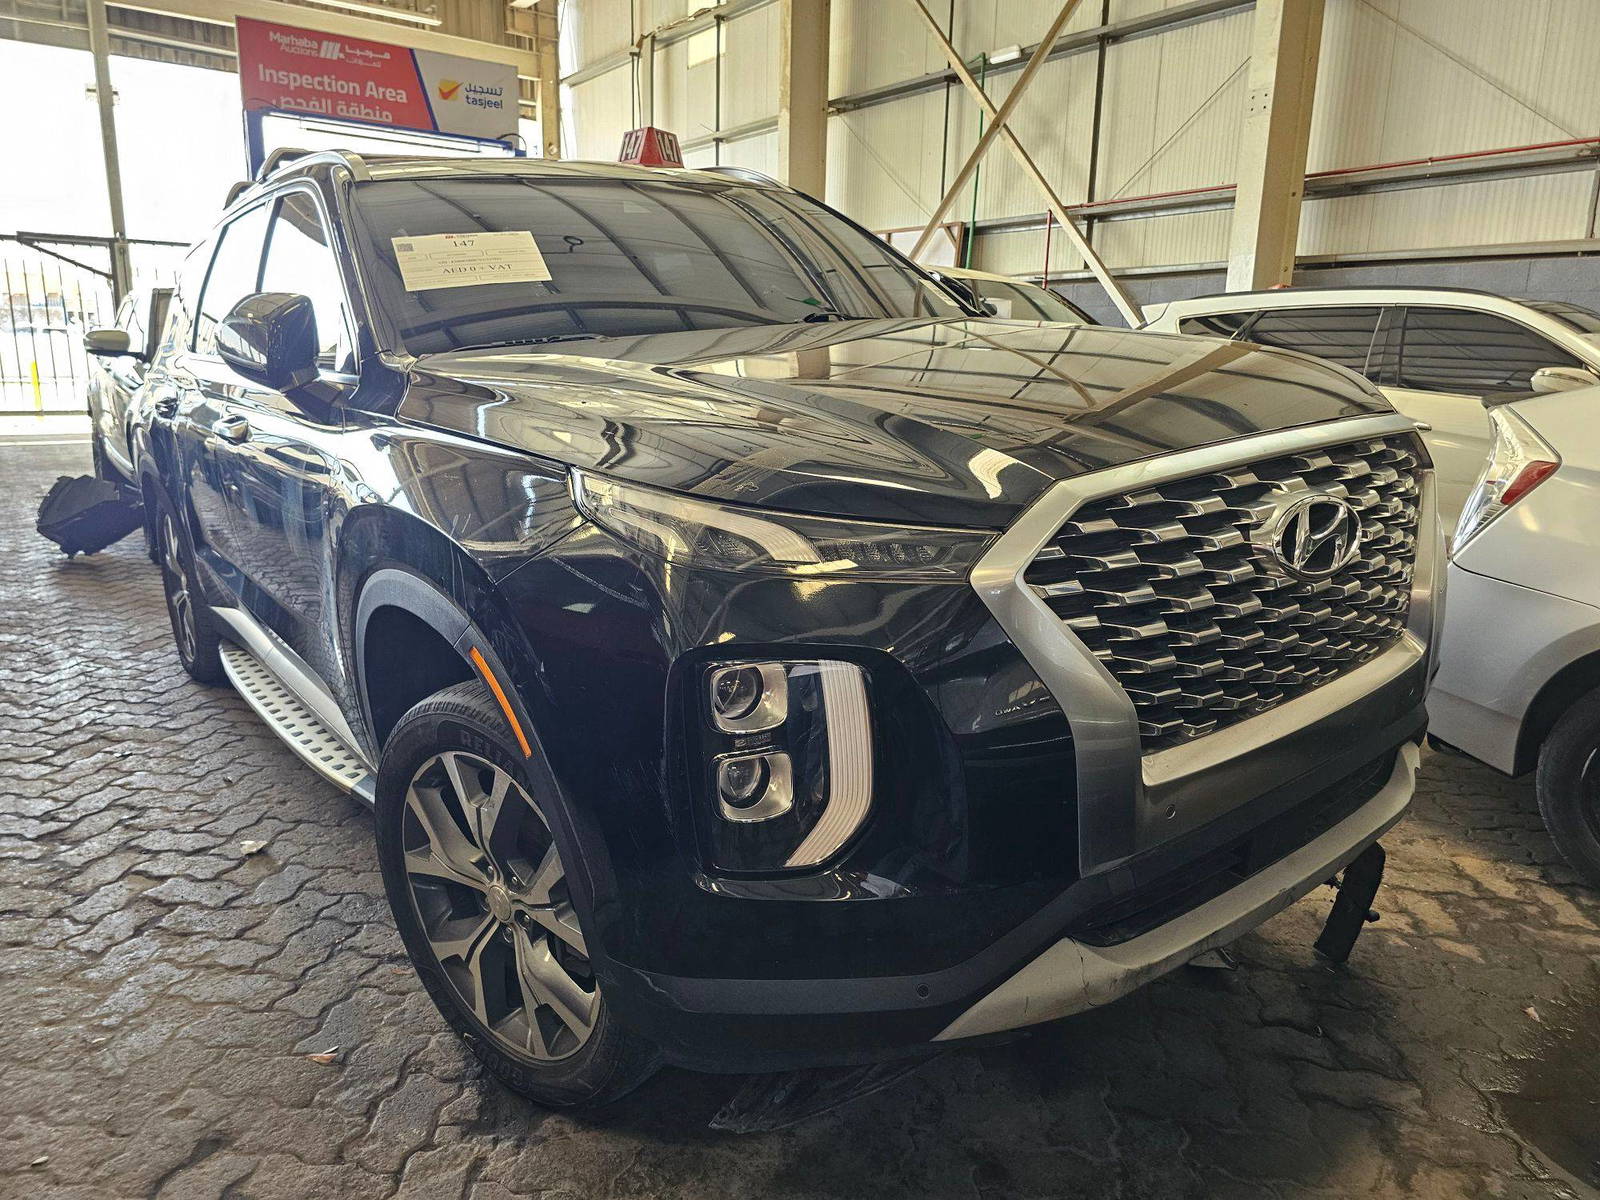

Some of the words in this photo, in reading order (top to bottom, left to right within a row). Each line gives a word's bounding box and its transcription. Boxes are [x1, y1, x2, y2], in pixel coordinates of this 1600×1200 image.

[269, 31, 318, 49] Marhaba
[280, 44, 318, 57] Auctions
[345, 44, 391, 59] مرحبا
[258, 63, 361, 96] Inspection
[365, 81, 408, 103] Area
[465, 83, 503, 97] تسجيل
[466, 95, 503, 109] tasjeel
[337, 102, 393, 122] منطقة
[621, 131, 643, 161] 147
[658, 132, 678, 163] 147
[453, 240, 475, 248] 147
[488, 264, 513, 272] VAT
